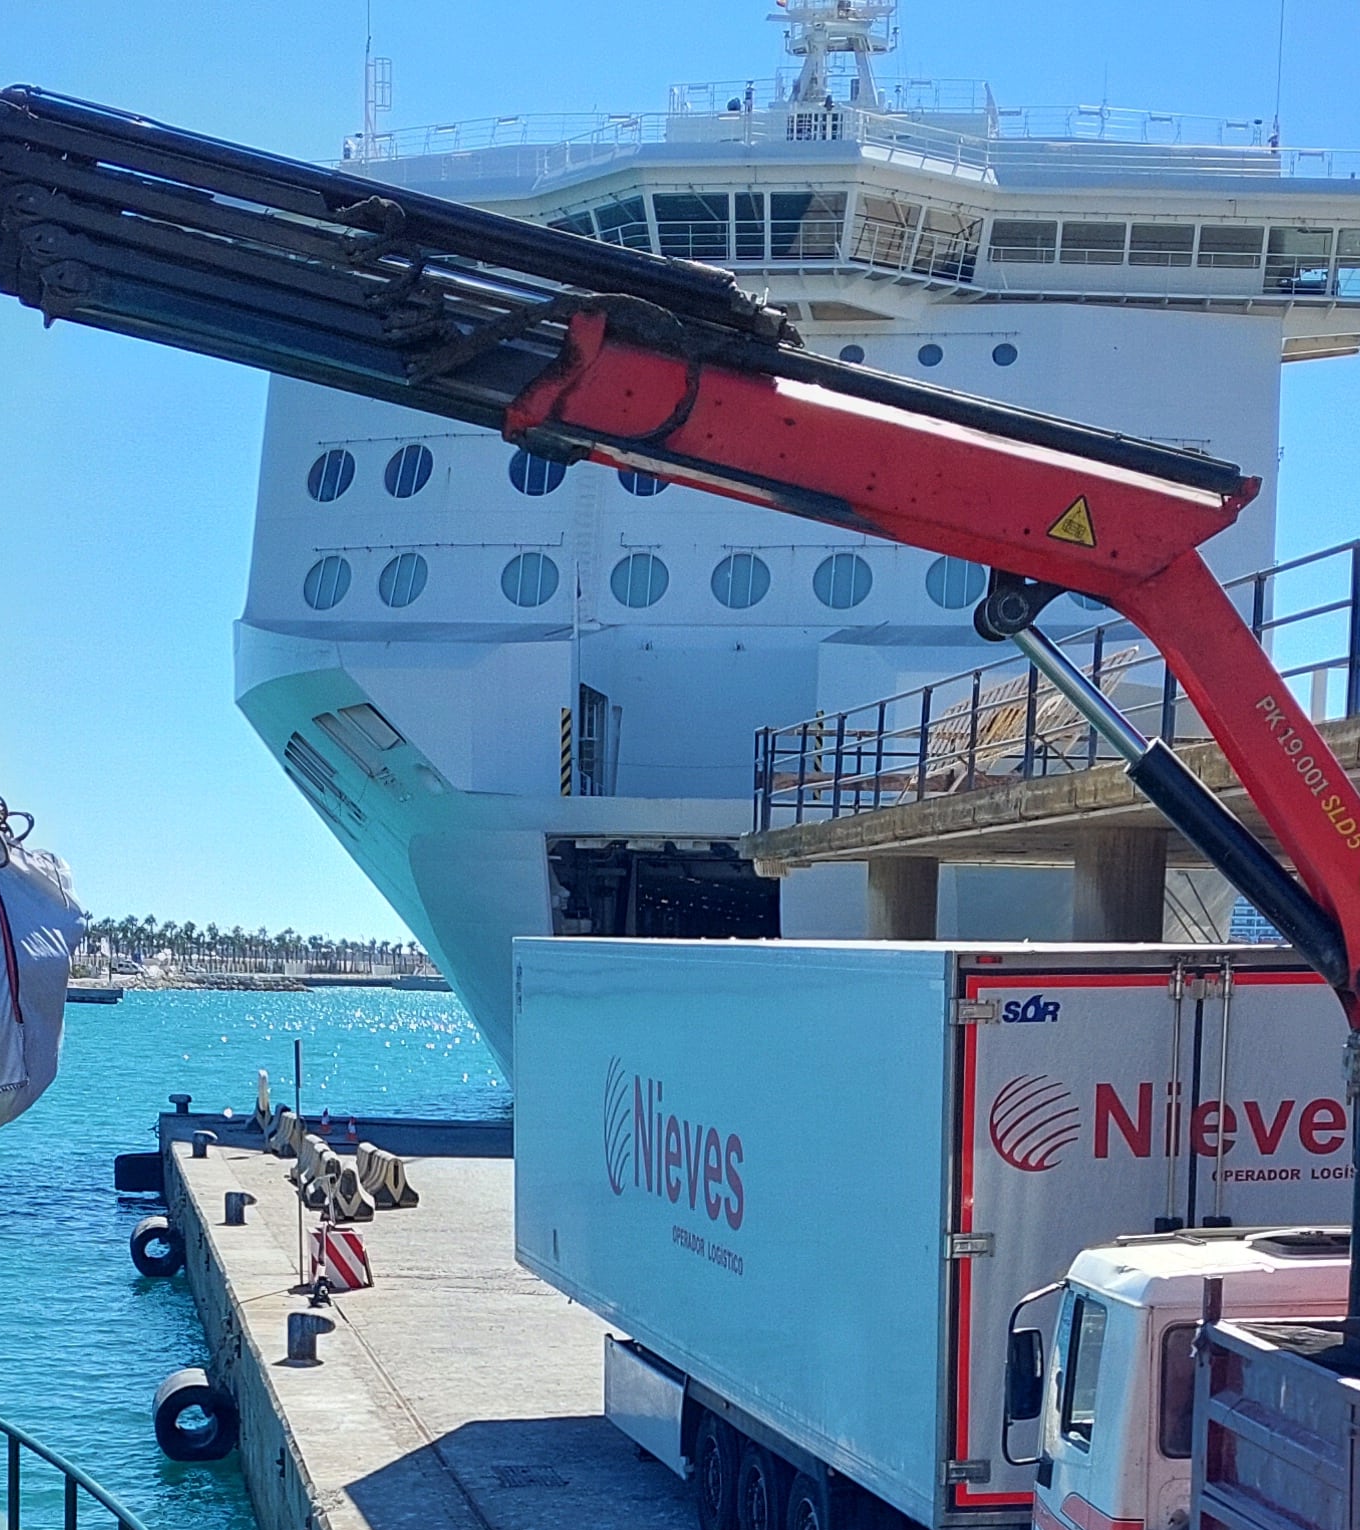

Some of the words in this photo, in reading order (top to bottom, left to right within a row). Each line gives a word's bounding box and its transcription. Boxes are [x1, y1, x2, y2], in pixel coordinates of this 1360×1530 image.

[1255, 695, 1286, 731] PK
[1277, 727, 1329, 797] 19.001
[634, 1074, 744, 1231] Nieves
[1094, 1081, 1346, 1159] Nieve
[672, 1224, 705, 1257] OPERADOR
